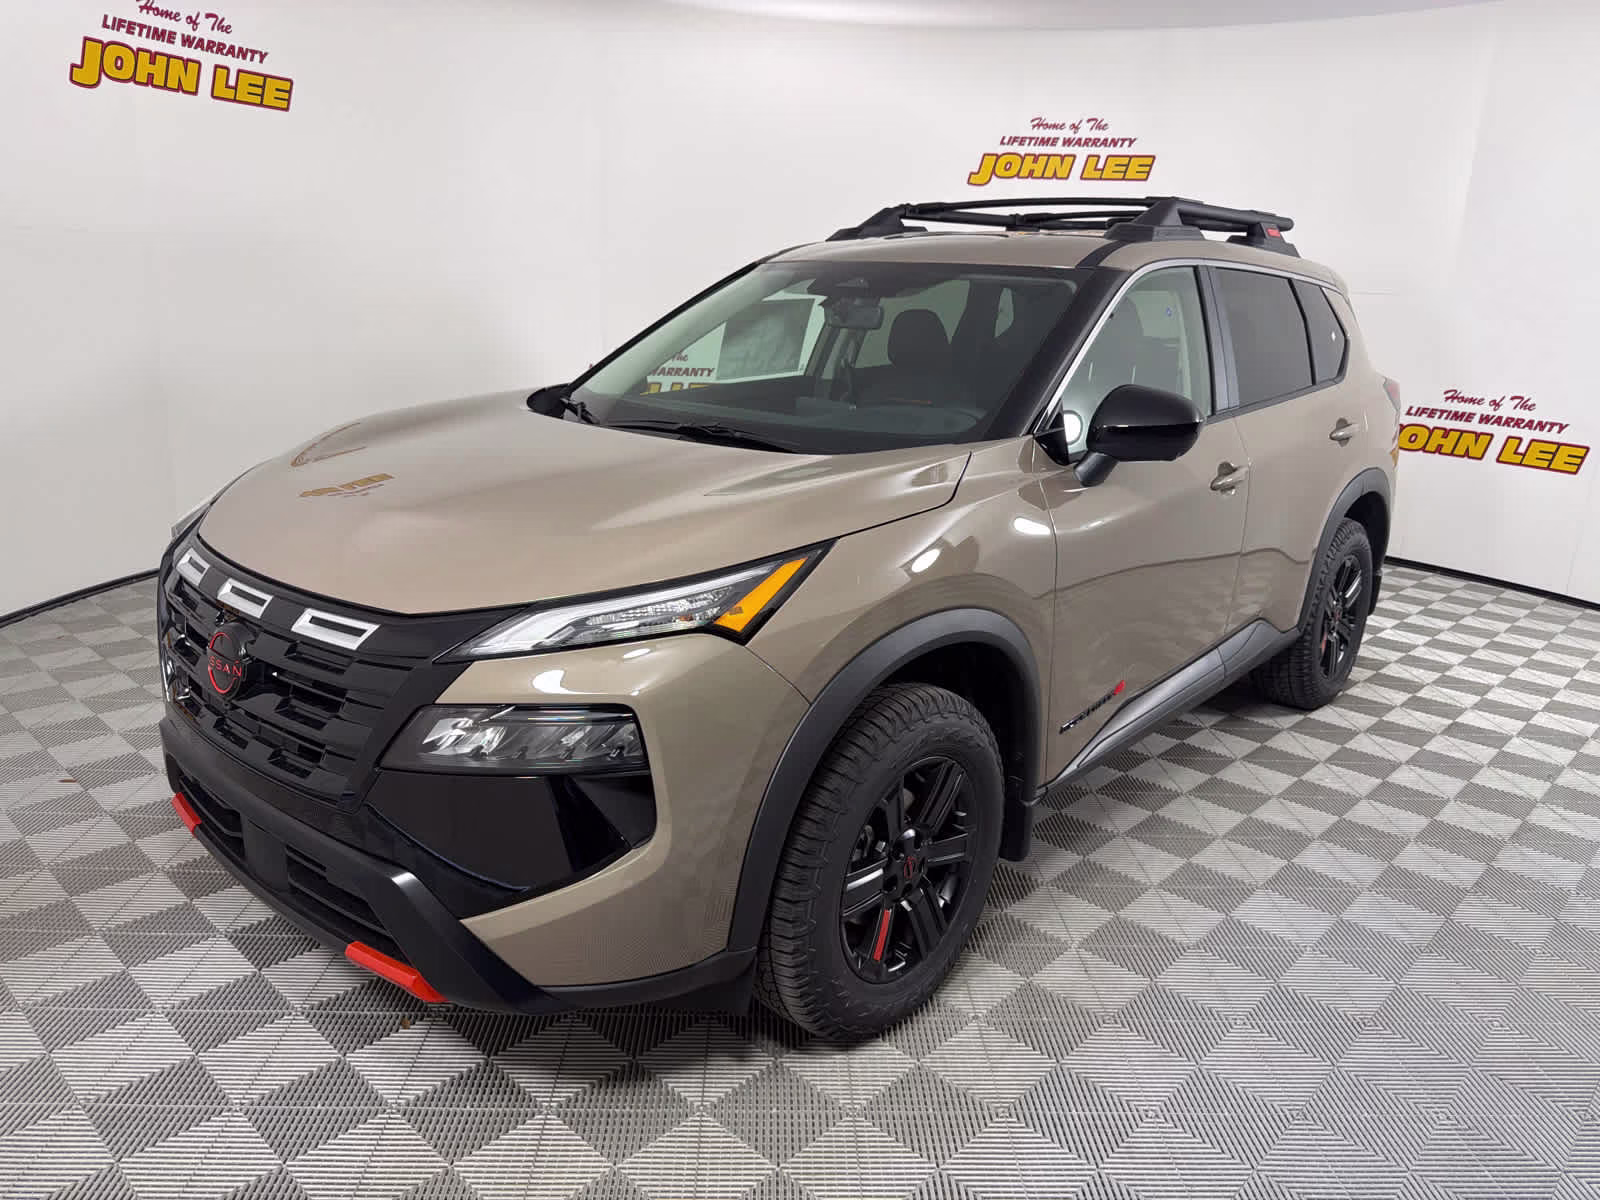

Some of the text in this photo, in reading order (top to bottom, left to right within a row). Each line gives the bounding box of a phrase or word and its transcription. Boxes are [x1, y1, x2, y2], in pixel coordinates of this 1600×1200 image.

[136, 0, 232, 34] Home of The
[102, 14, 268, 64] LIFETIME WARRANTY
[70, 36, 293, 112] JOHN LEE
[1030, 117, 1108, 134] Home of The
[1000, 136, 1137, 148] LIFETIME WARRANTY
[968, 152, 1156, 186] JOHN LEE
[1443, 389, 1536, 411] Home of The
[1405, 406, 1570, 434] LIFETIME WARRANTY
[1398, 423, 1590, 475] OHN LEE
[208, 655, 243, 677] SSAN
